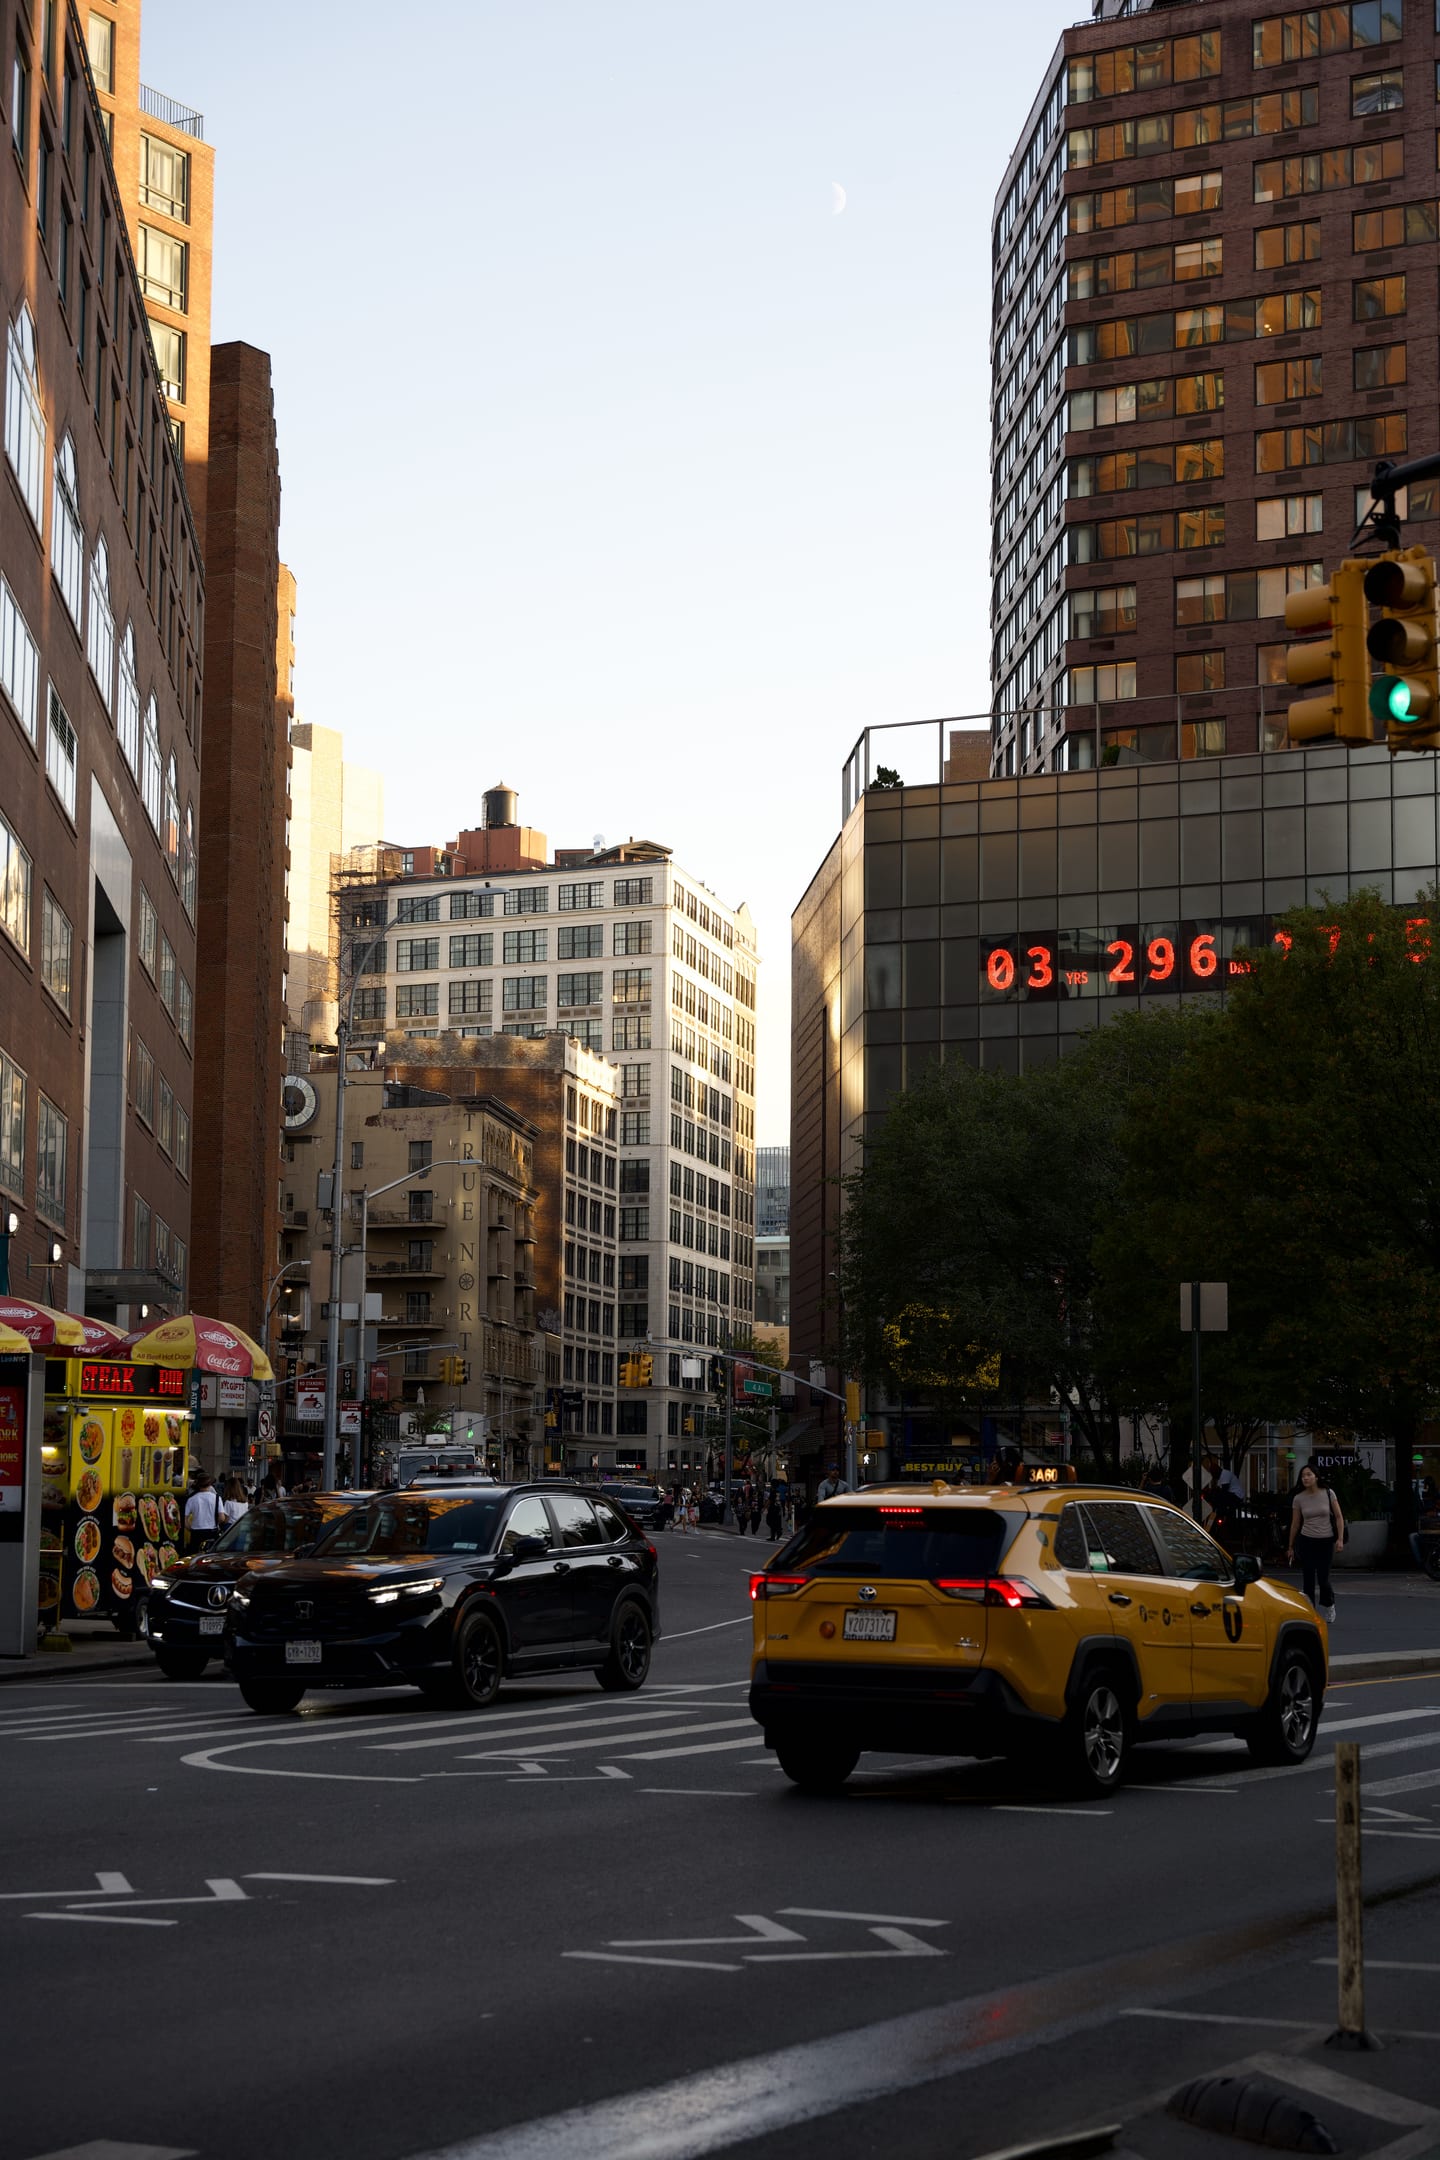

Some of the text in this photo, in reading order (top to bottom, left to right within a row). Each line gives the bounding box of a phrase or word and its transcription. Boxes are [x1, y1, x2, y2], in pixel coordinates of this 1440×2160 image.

[987, 946, 1053, 990] 03
[1065, 971, 1089, 985] YRS
[1106, 934, 1217, 982] 296
[462, 1113, 476, 1221] TRUE
[82, 1366, 135, 1392] STEAK
[905, 1463, 963, 1472] BEST BUY
[1028, 1467, 1058, 1483] 3A60
[848, 1617, 891, 1633] Y207317C
